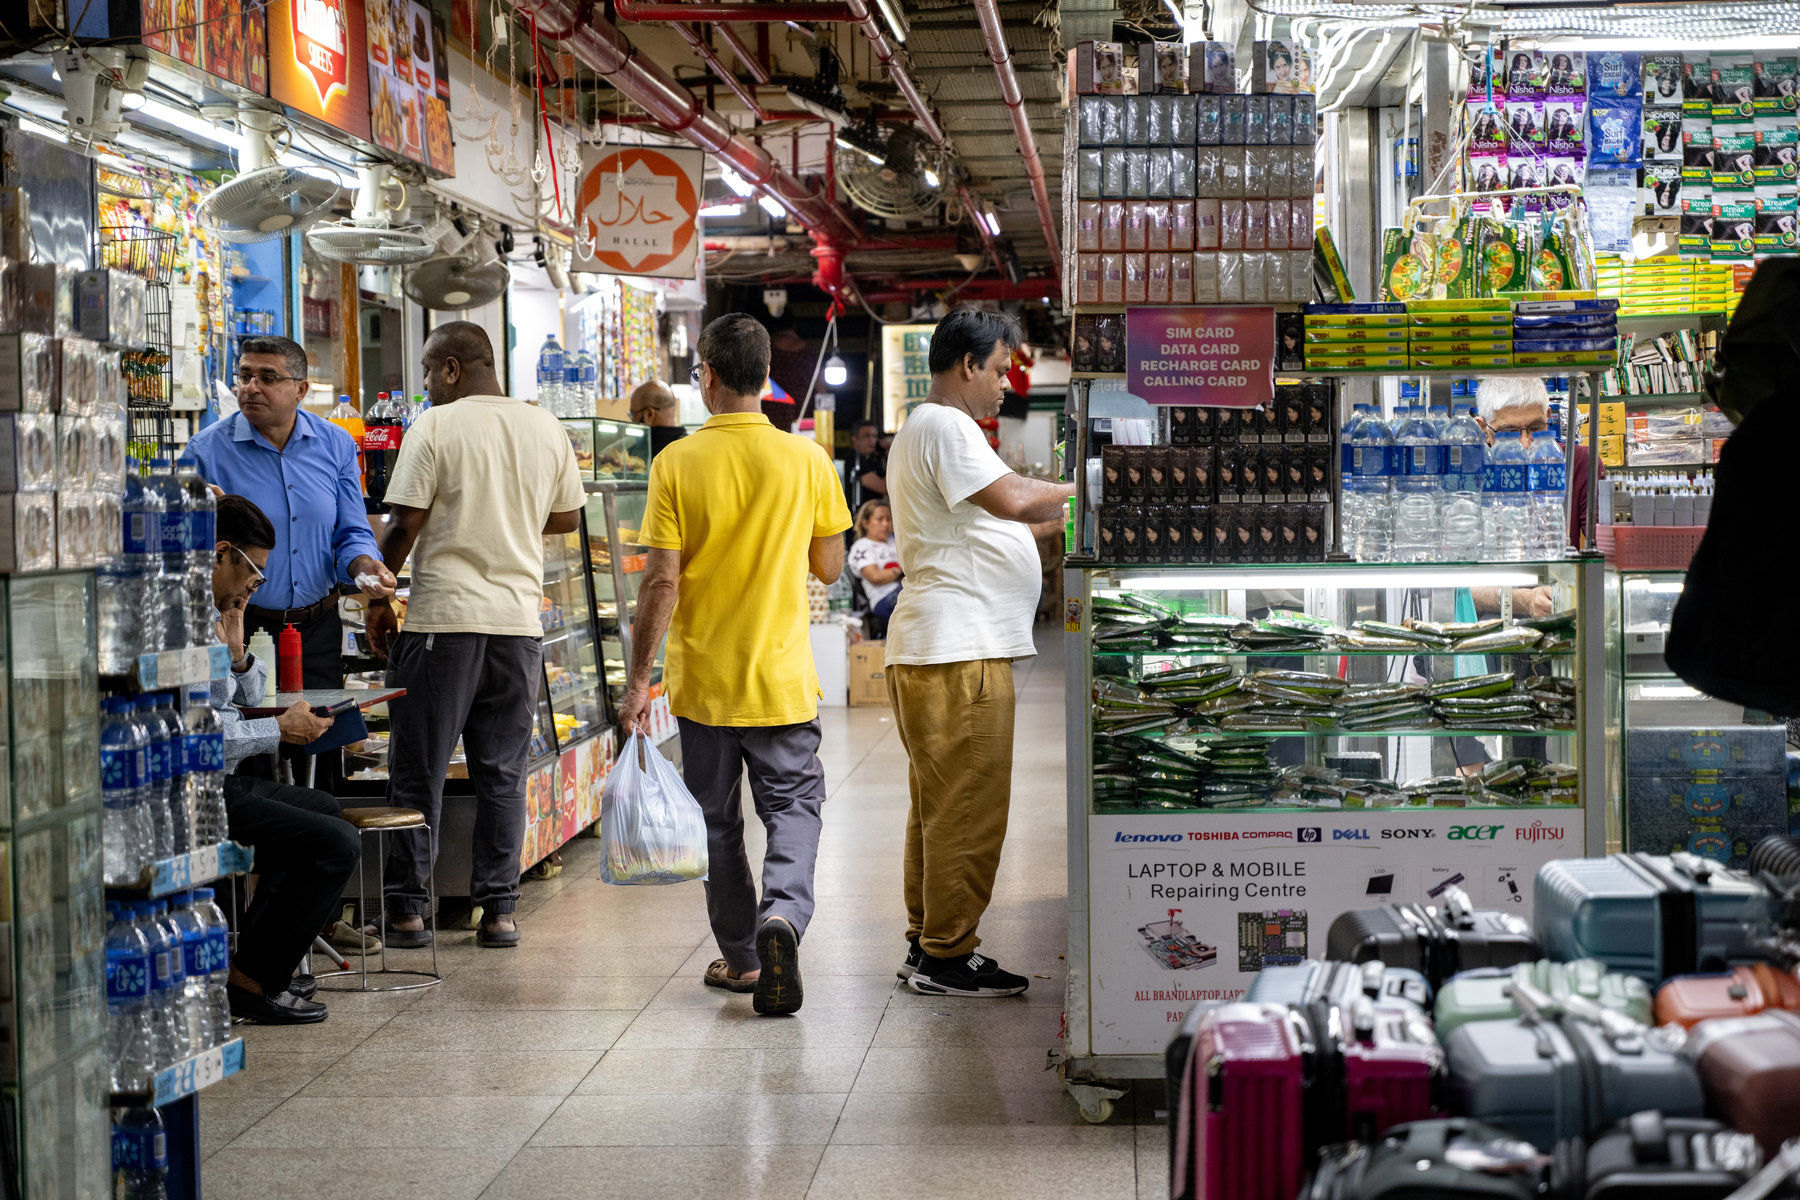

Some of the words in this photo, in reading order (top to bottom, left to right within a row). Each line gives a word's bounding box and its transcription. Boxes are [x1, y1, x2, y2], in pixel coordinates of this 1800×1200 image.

[1655, 56, 1680, 64] Nisha
[1603, 61, 1623, 71] Surf
[1510, 86, 1535, 94] Nisha
[1549, 86, 1575, 94] Nisha
[1604, 128, 1624, 138] Surf
[1473, 140, 1499, 149] Nisha
[1510, 141, 1536, 149] Nisha
[1549, 141, 1575, 149] Nisha
[1721, 137, 1746, 145] streax
[1512, 196, 1537, 204] Nsha
[1551, 196, 1571, 205] Nish
[599, 191, 673, 227] حلال
[1722, 205, 1746, 213] streax
[1464, 216, 1475, 245] Henna
[612, 236, 659, 247] HALAL
[1165, 327, 1192, 339] SIM
[1195, 327, 1234, 338] CARD
[1161, 344, 1197, 355] DATA
[1200, 344, 1240, 355] CARD
[1140, 360, 1218, 371] RECHARGE
[1221, 359, 1261, 371] CARD
[1144, 376, 1205, 387] CALLING
[1207, 376, 1248, 387] CARD
[1114, 831, 1184, 843] lenovo
[1187, 832, 1239, 841] TOSHIBA
[1242, 831, 1293, 840] COMPAQ
[1332, 829, 1370, 841] DELL
[1447, 825, 1504, 840] acer
[1515, 820, 1564, 844] FUJITSU
[1128, 862, 1207, 878] LAPTOP
[1212, 862, 1225, 877] &
[1230, 861, 1306, 877] MOBILE
[1151, 883, 1240, 902] Repairing
[1245, 882, 1306, 897] Centre
[1134, 991, 1152, 1001] ALL
